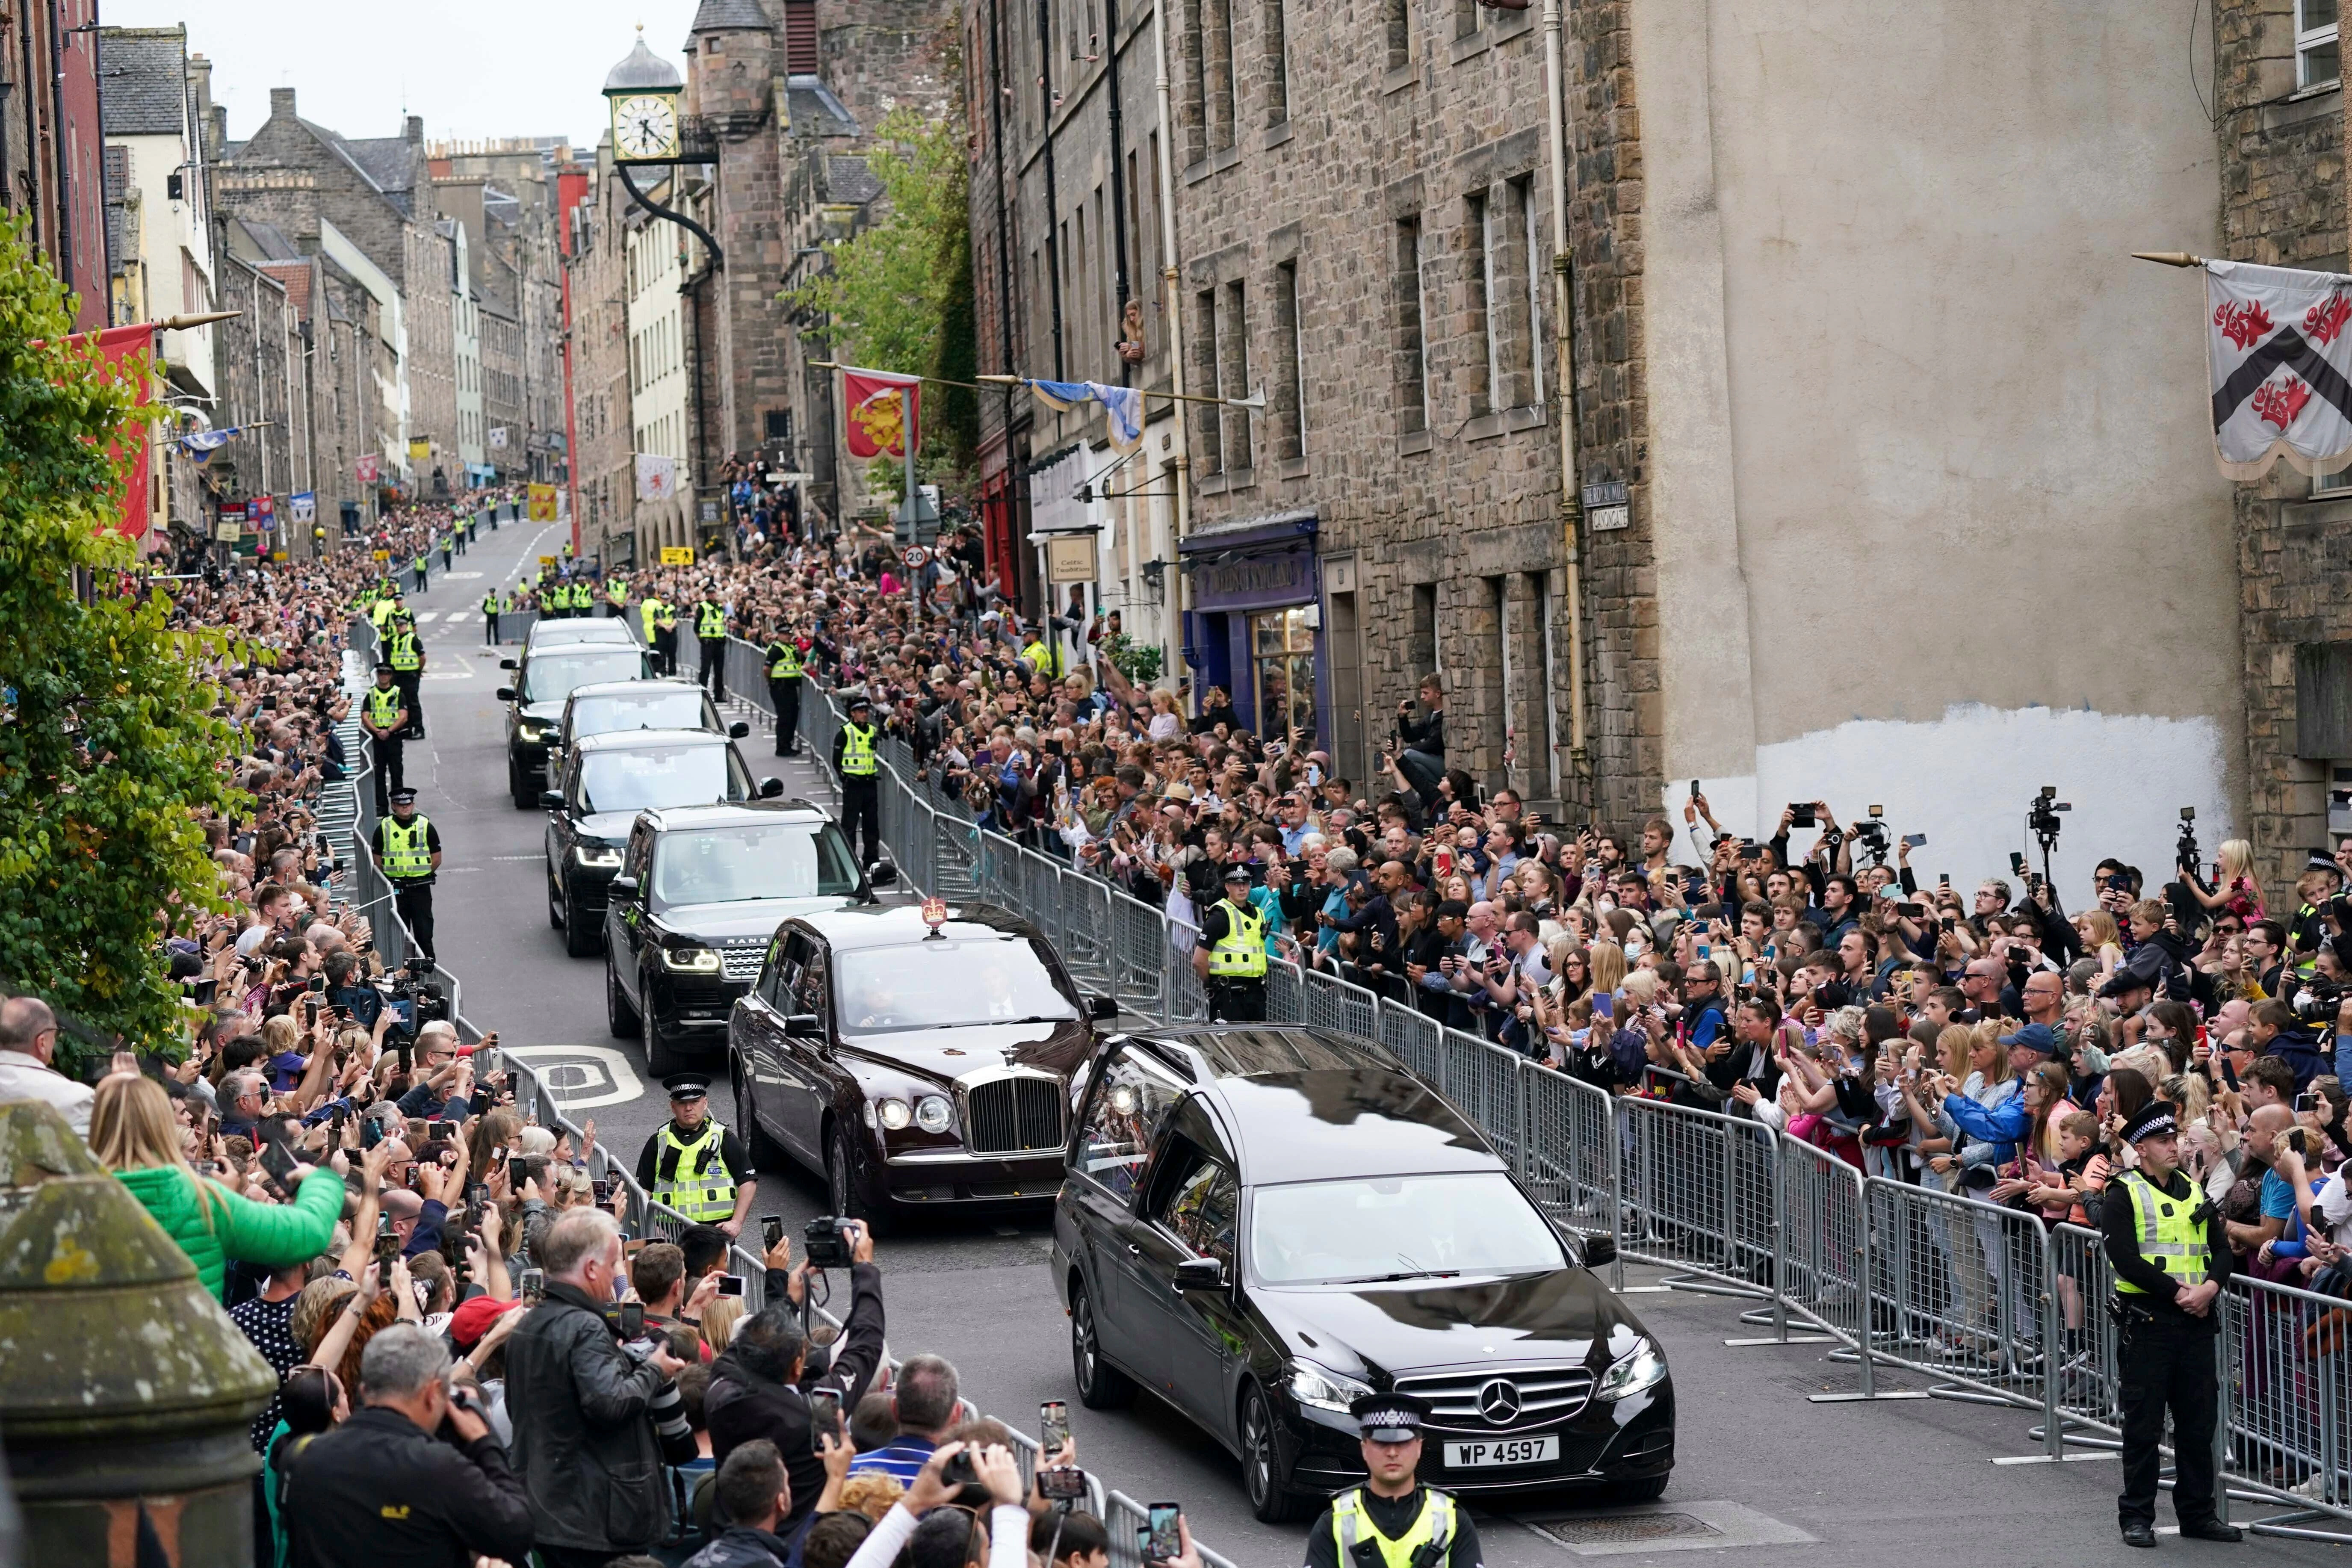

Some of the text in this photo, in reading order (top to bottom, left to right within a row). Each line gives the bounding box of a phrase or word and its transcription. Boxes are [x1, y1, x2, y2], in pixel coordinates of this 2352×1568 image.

[1584, 484, 1626, 504] THE ROYAL MILE
[1594, 509, 1627, 528] CANONGATE
[907, 552, 923, 561] 20
[1460, 1440, 1545, 1464] WP 4597
